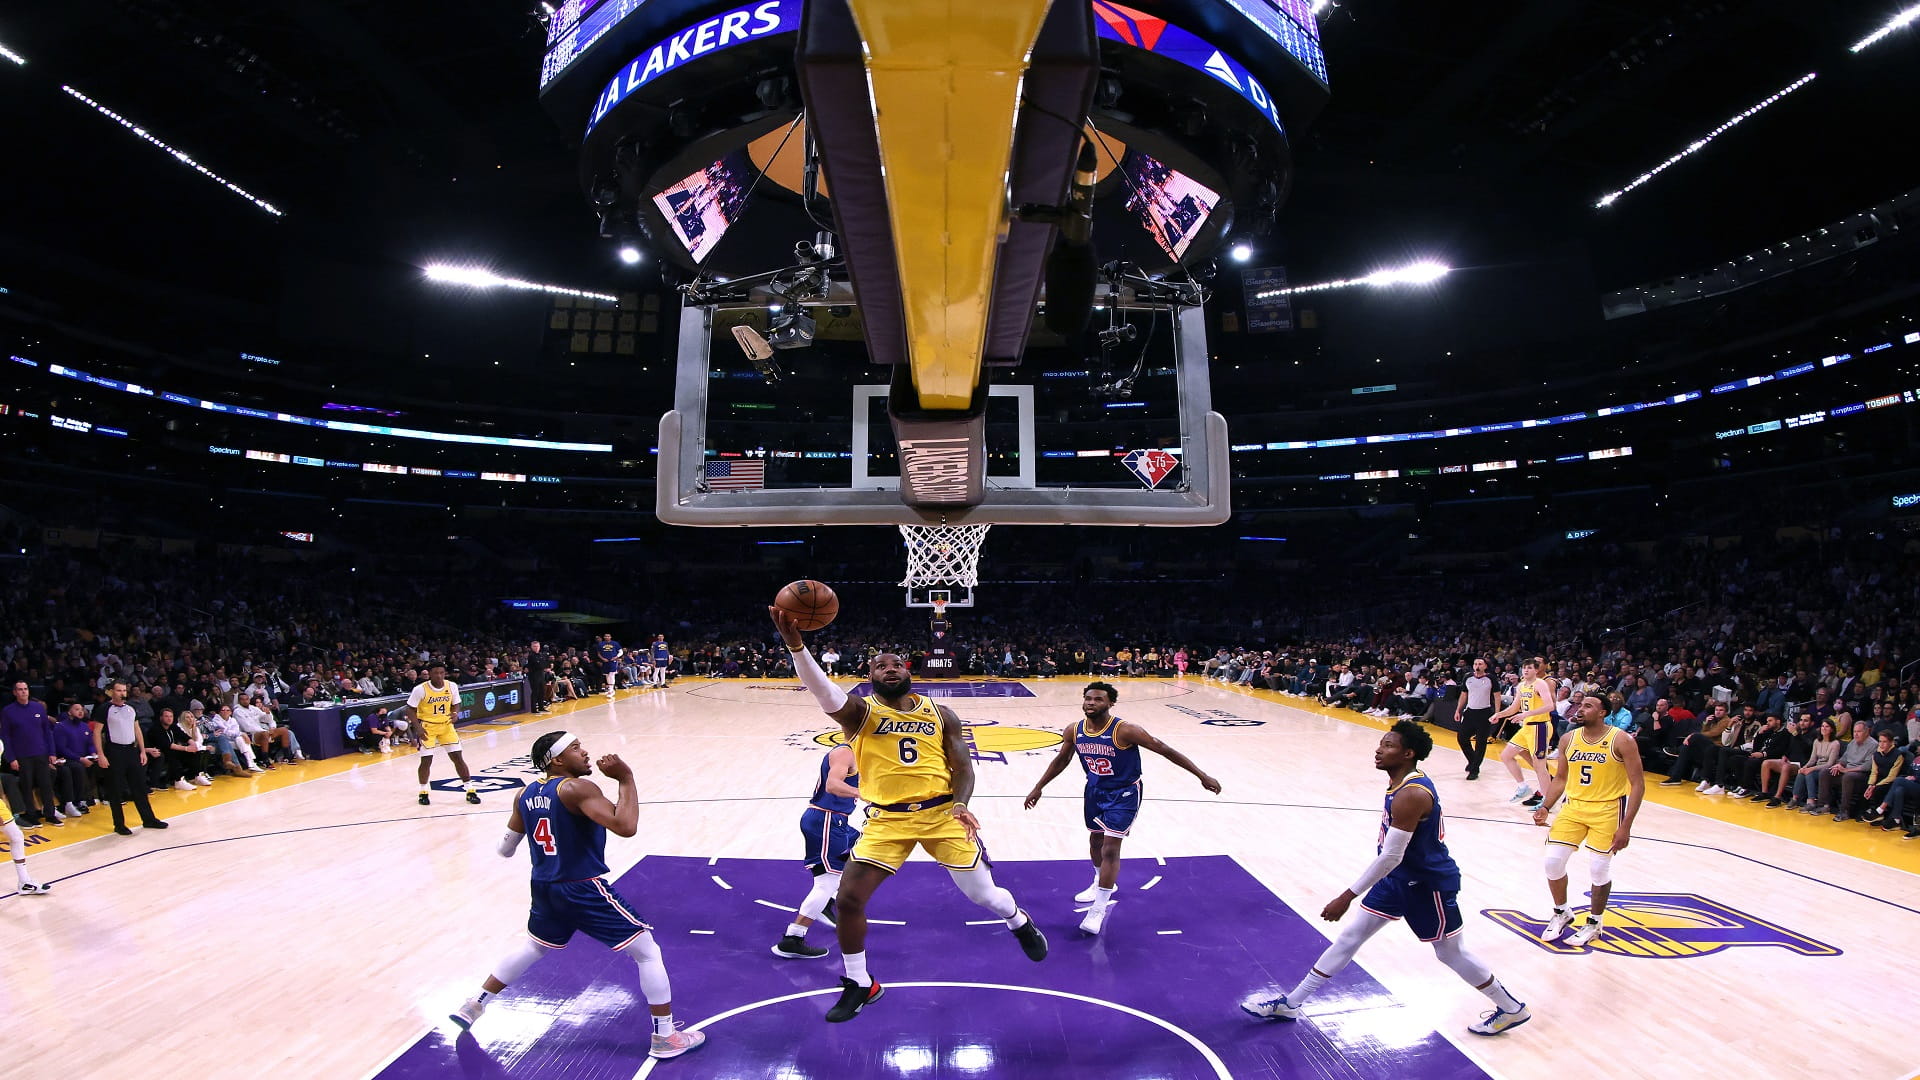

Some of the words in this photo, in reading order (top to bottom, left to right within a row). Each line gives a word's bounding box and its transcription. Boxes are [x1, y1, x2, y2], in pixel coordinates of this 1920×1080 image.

[626, 1, 780, 93] LAKERS
[1247, 75, 1283, 133] DE
[1835, 403, 1865, 415] crypto.com
[1865, 395, 1900, 409] TOSHIBA
[1715, 427, 1745, 440] Spectrum
[209, 445, 240, 455] Spectrum
[1155, 456, 1166, 468] 75
[411, 467, 441, 476] TOSHIBA
[427, 696, 450, 704] LAKERS
[433, 703, 446, 715] 14
[872, 717, 936, 736] LAKERS
[898, 737, 918, 766] 6
[1569, 749, 1607, 764] LAKERS
[1084, 755, 1115, 776] 22
[1580, 764, 1593, 786] 5
[533, 817, 558, 856] 4
